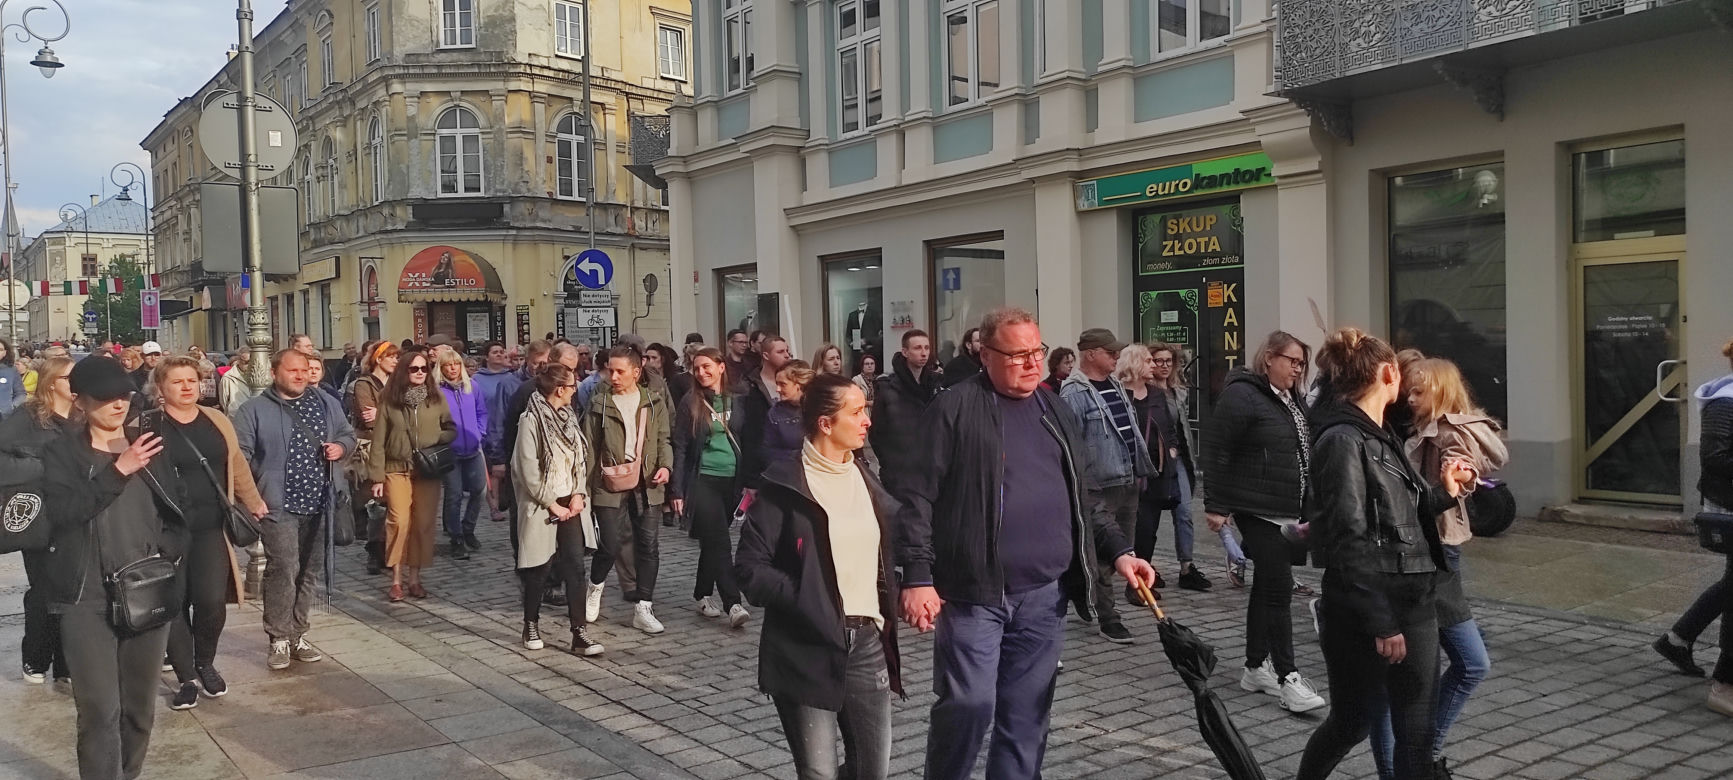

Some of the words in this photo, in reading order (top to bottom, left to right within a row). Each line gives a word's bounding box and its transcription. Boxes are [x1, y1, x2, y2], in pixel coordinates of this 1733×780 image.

[1167, 214, 1217, 235] SKUP
[1162, 236, 1221, 257] ZŁOTA
[444, 278, 476, 286] ESTILO
